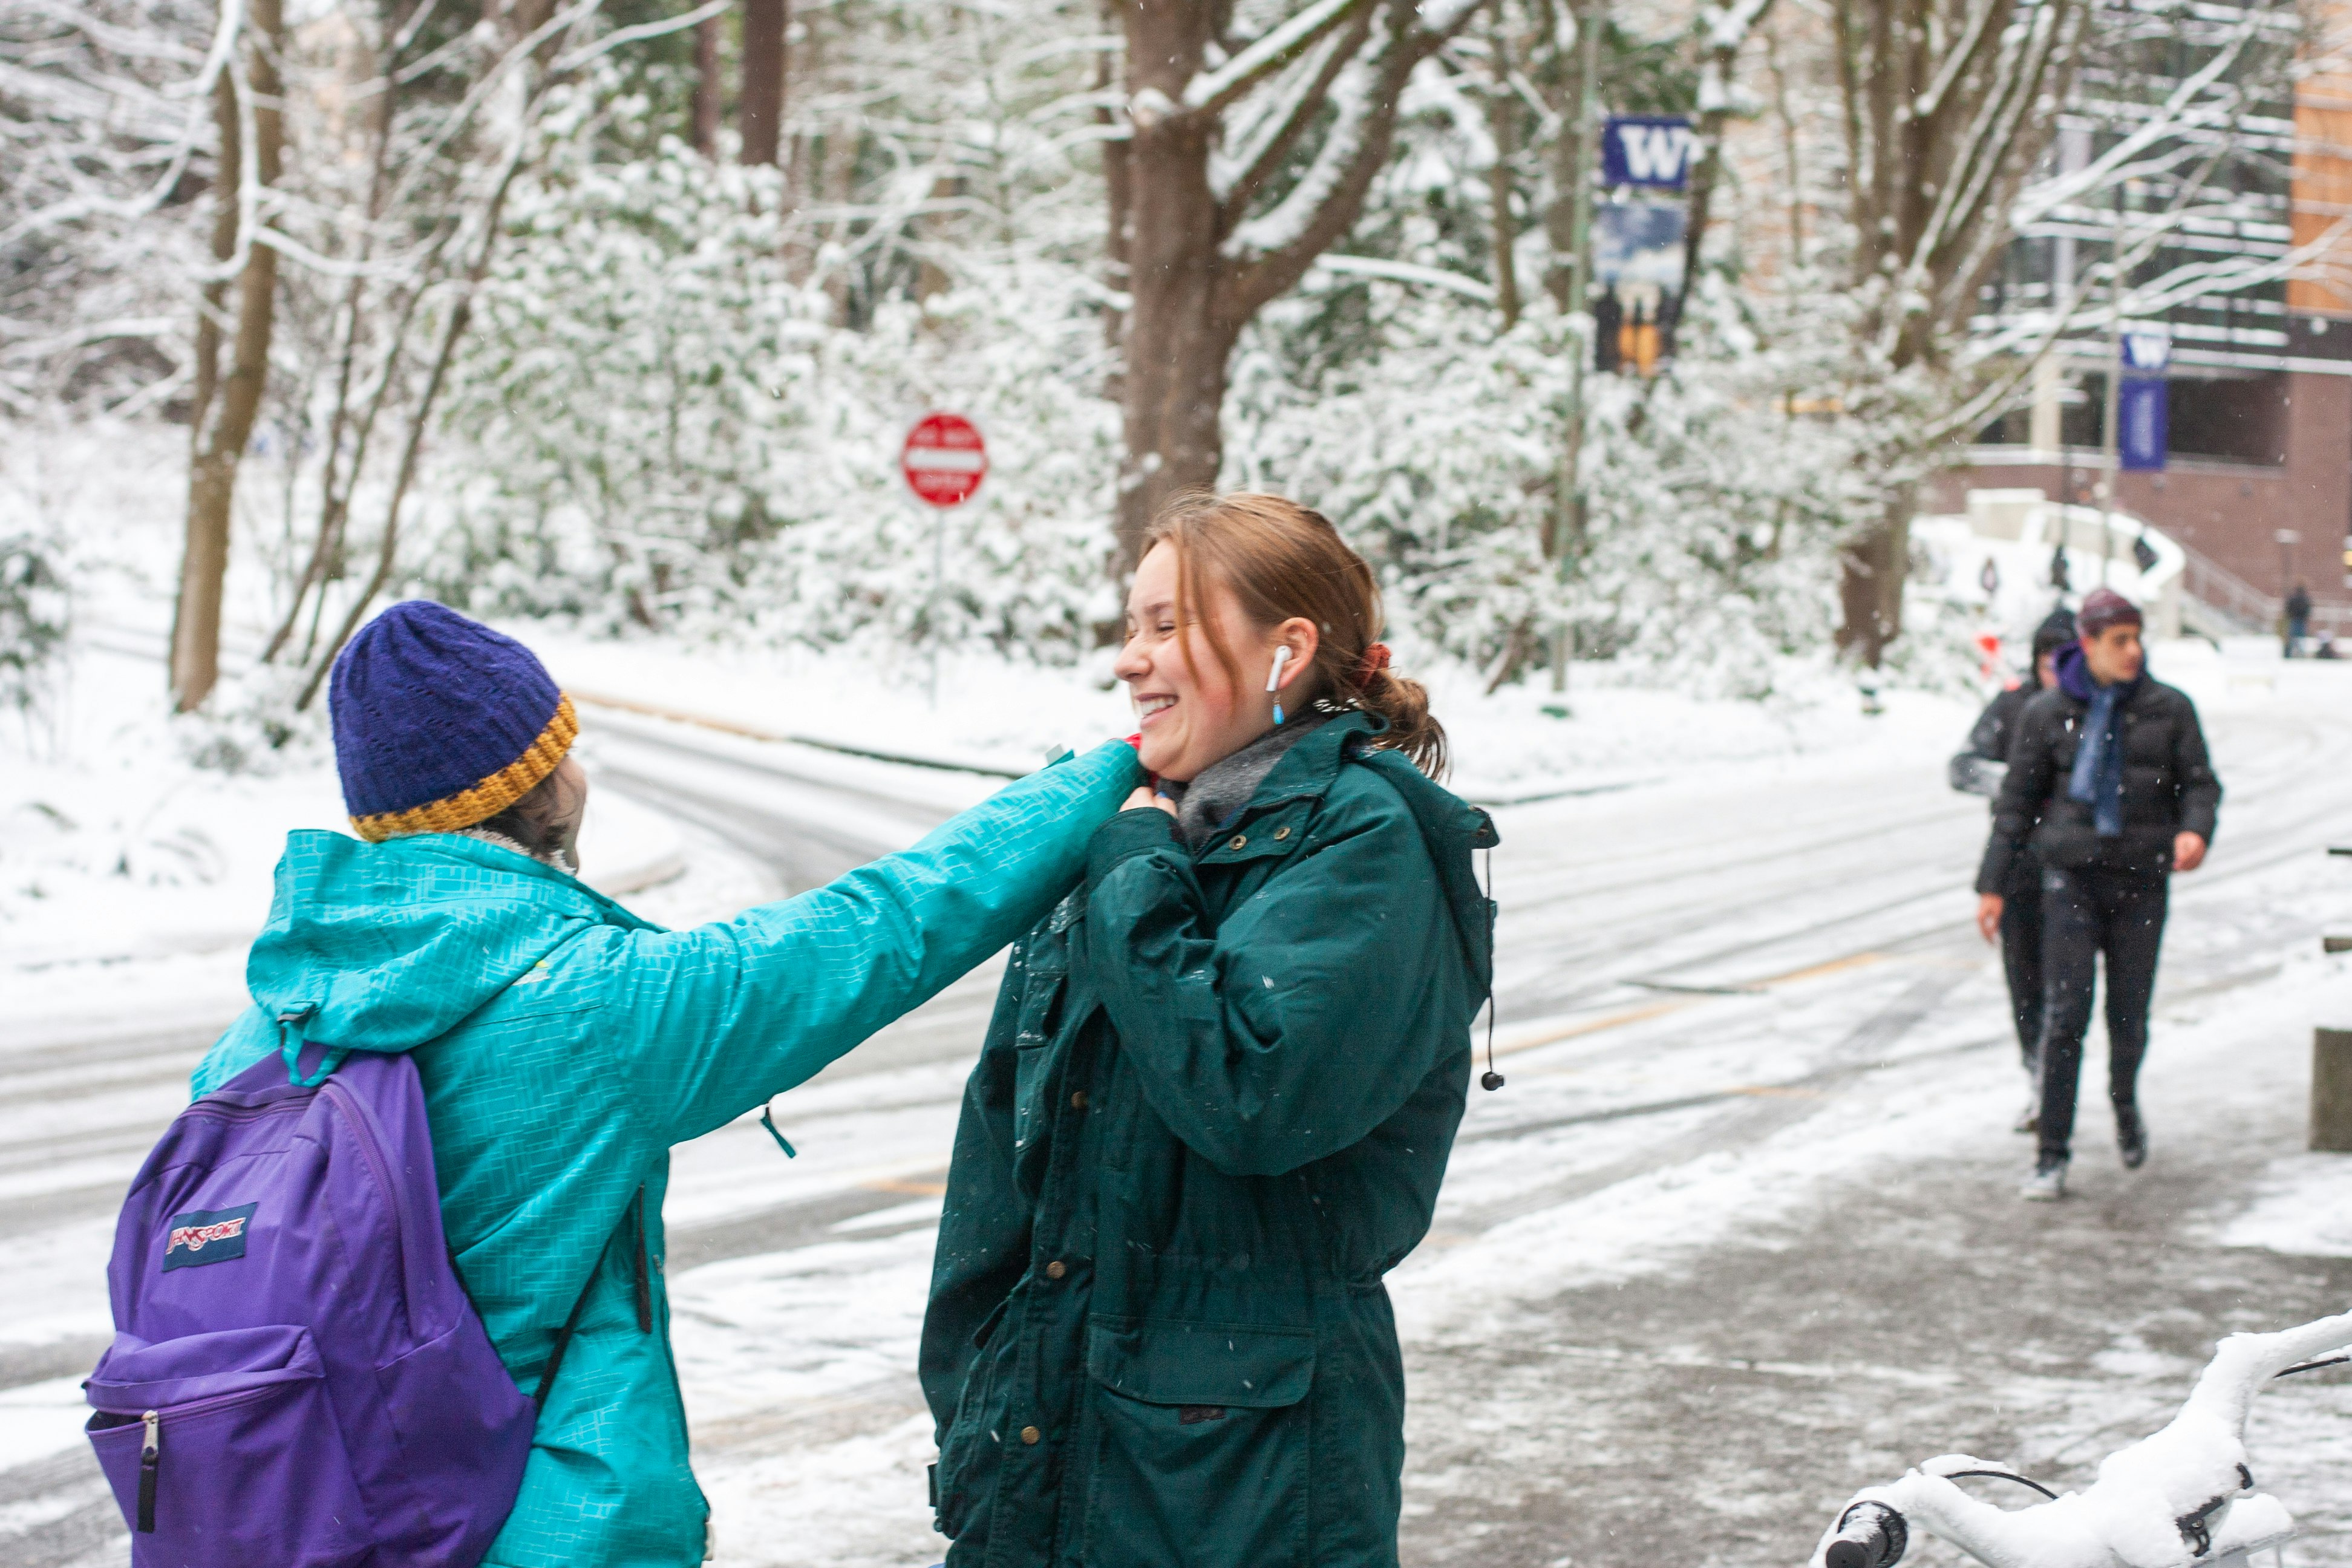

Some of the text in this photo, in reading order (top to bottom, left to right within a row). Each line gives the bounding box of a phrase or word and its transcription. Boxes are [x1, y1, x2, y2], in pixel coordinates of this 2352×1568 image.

[1617, 124, 1693, 181] W
[2131, 334, 2170, 368] W
[165, 1217, 246, 1255] JANSPORT
